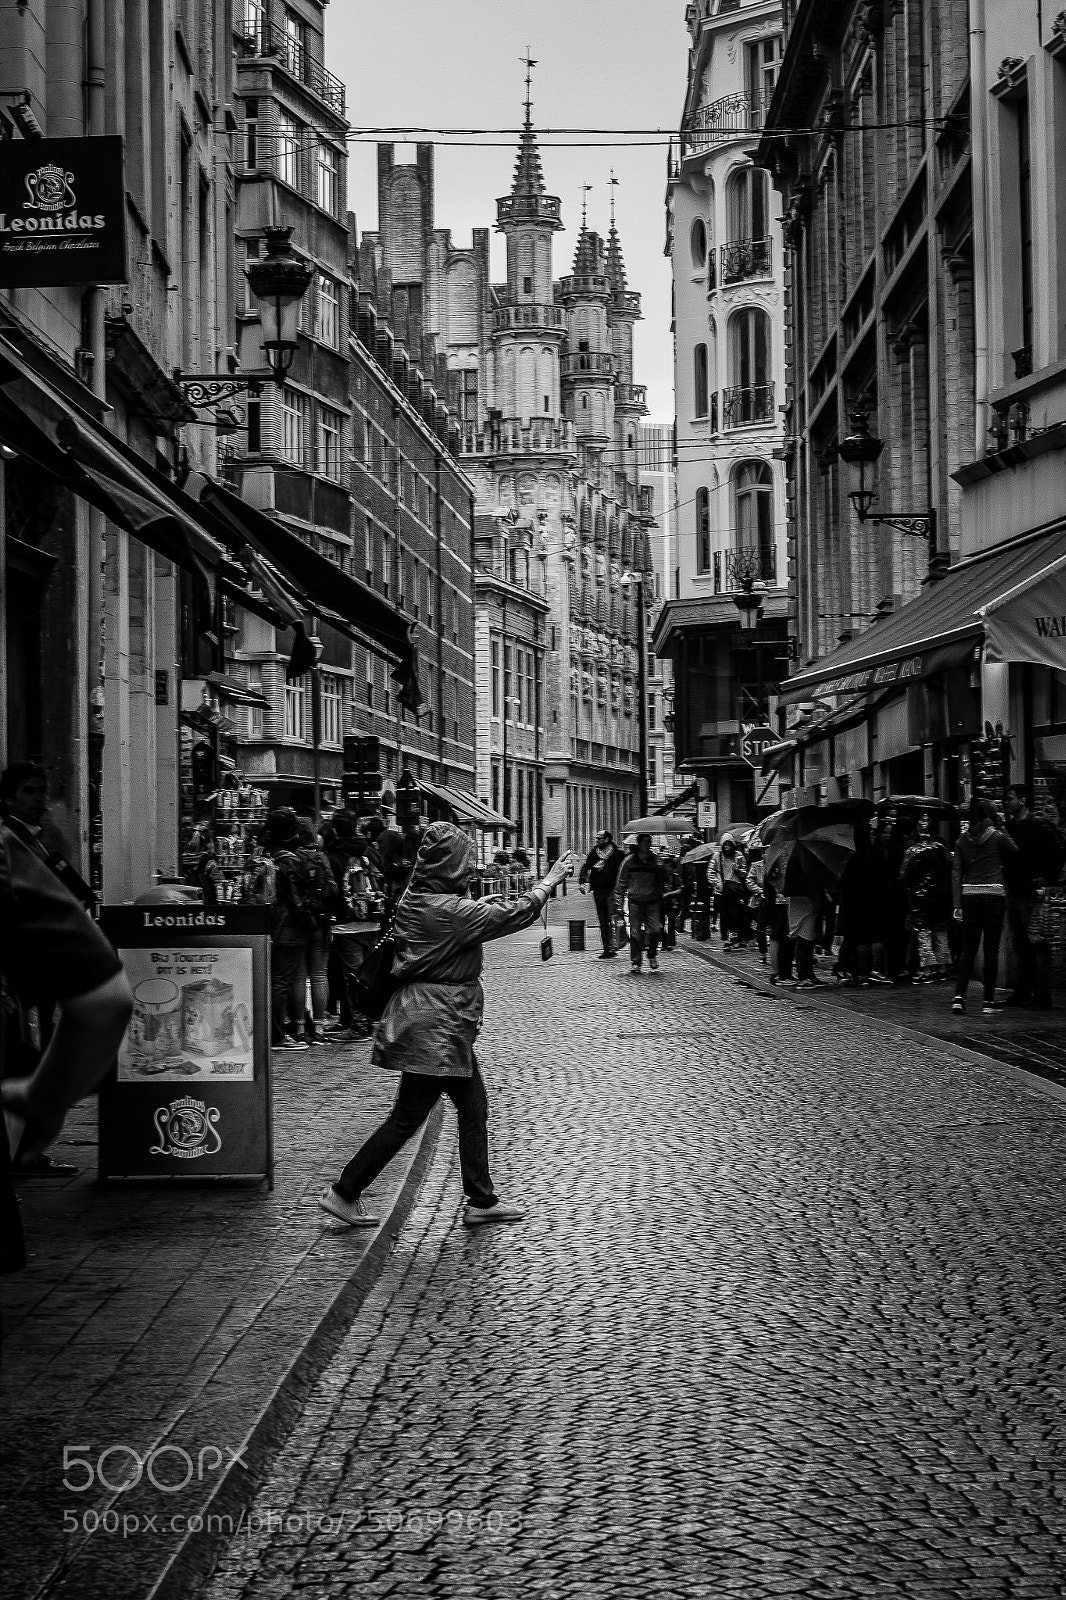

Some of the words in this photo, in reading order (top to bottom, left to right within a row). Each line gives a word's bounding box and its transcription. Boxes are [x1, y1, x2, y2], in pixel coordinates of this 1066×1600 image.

[0, 210, 106, 232] Leonidas
[743, 740, 780, 756] ST
[143, 912, 226, 927] Leonidas
